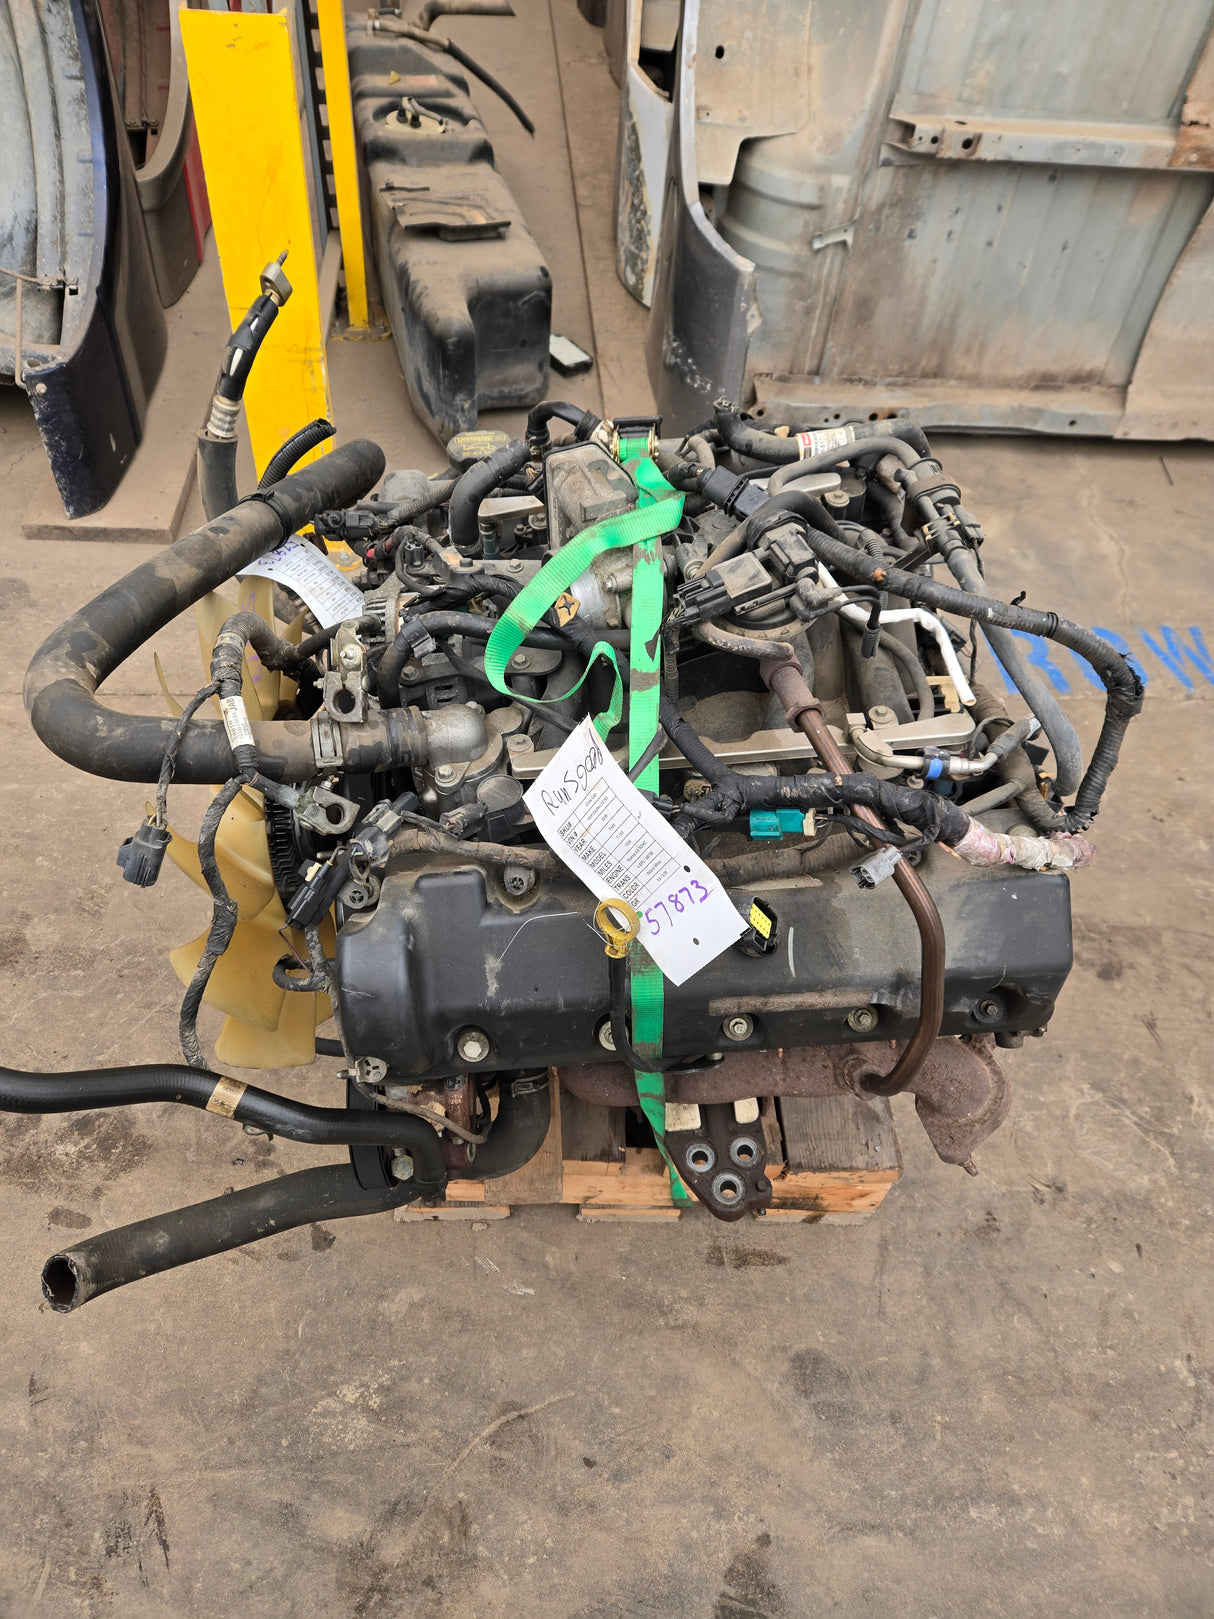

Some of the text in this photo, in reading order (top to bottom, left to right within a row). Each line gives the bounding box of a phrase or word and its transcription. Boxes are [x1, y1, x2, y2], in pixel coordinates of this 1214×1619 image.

[559, 820, 573, 837] SKU#
[565, 830, 579, 846] VIN #
[573, 838, 587, 854] YEAR
[581, 845, 596, 862] MAKE
[589, 850, 607, 869] MODEL
[597, 859, 613, 877] MILES
[606, 864, 624, 885] ENGINE
[613, 874, 631, 891] TRANS
[622, 881, 640, 899] COLOR
[631, 897, 641, 907] GR
[645, 879, 713, 935] 57873
